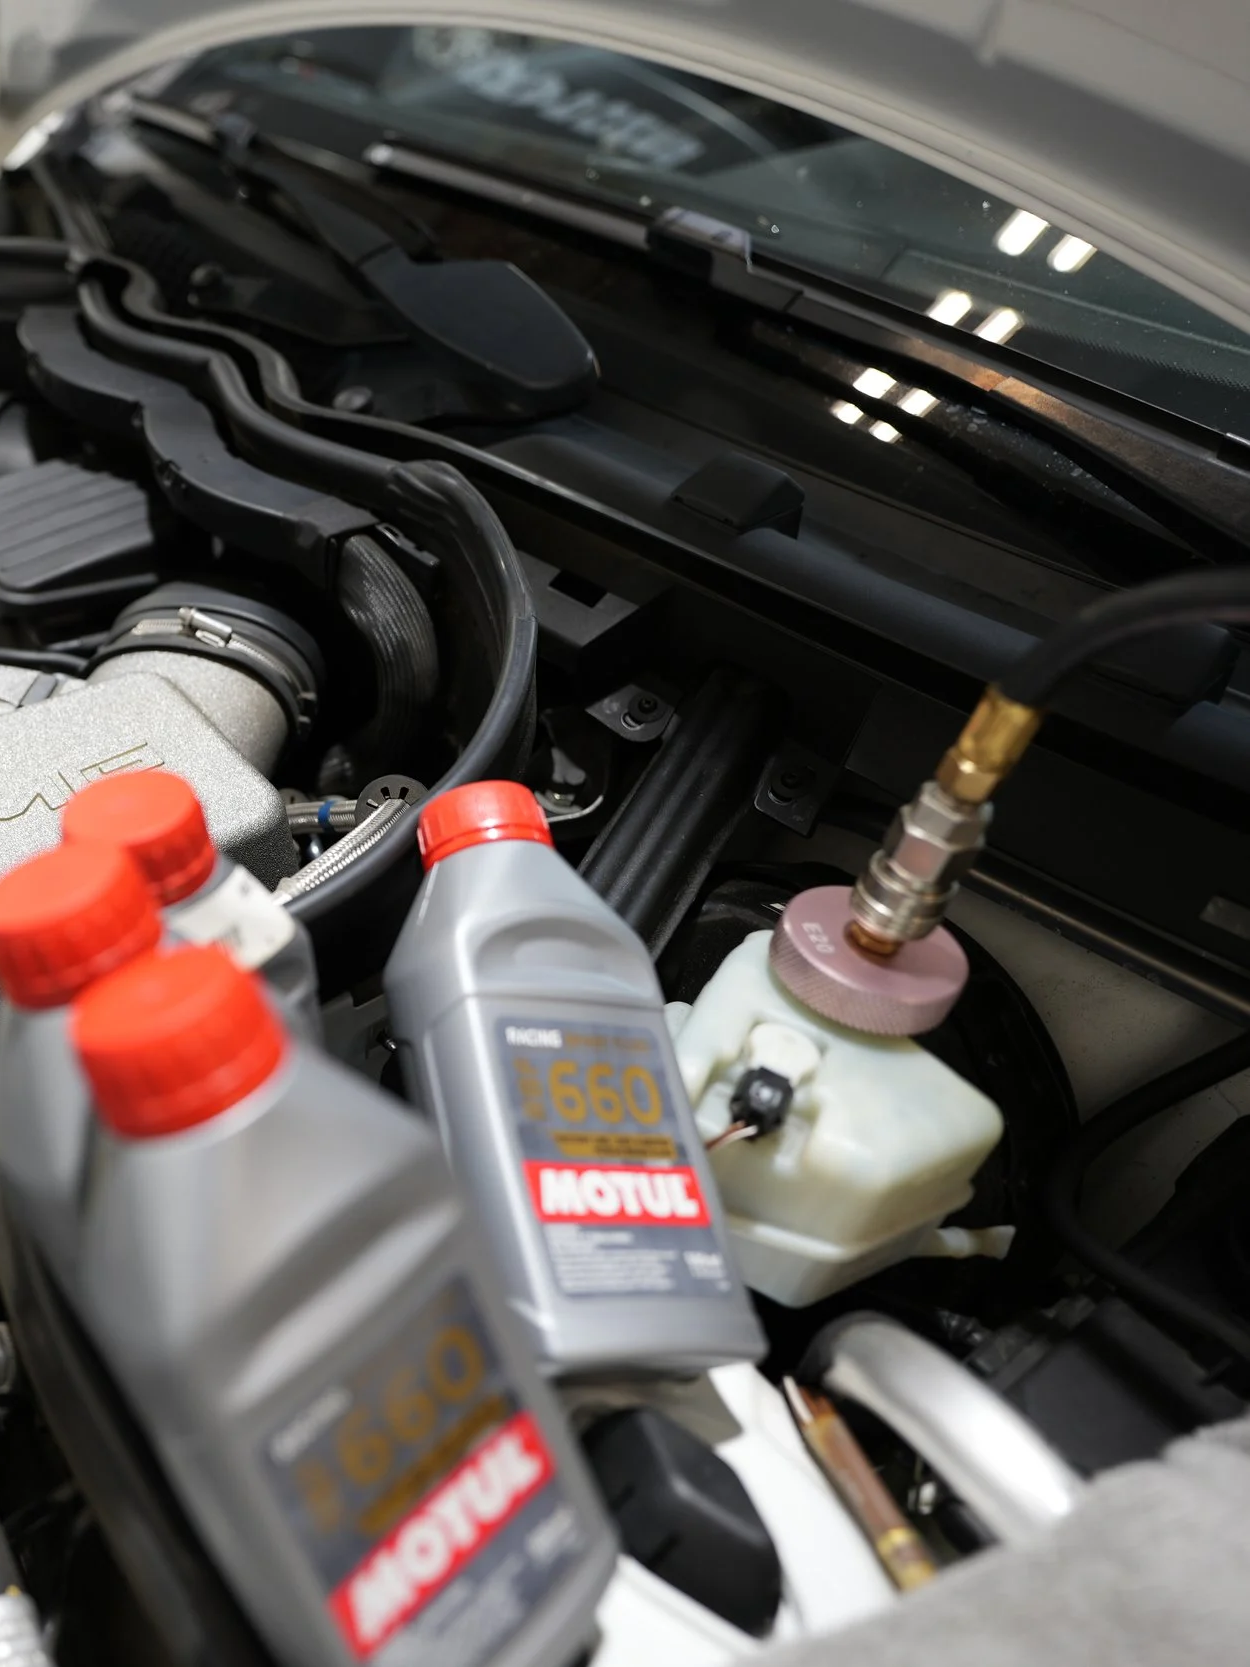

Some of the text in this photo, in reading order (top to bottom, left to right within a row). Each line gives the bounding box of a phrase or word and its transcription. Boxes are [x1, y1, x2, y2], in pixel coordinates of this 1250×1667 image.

[551, 1060, 662, 1125] 660
[539, 1168, 699, 1218] MOTUL
[337, 1327, 484, 1484] 660
[348, 1433, 542, 1643] MOTUL
